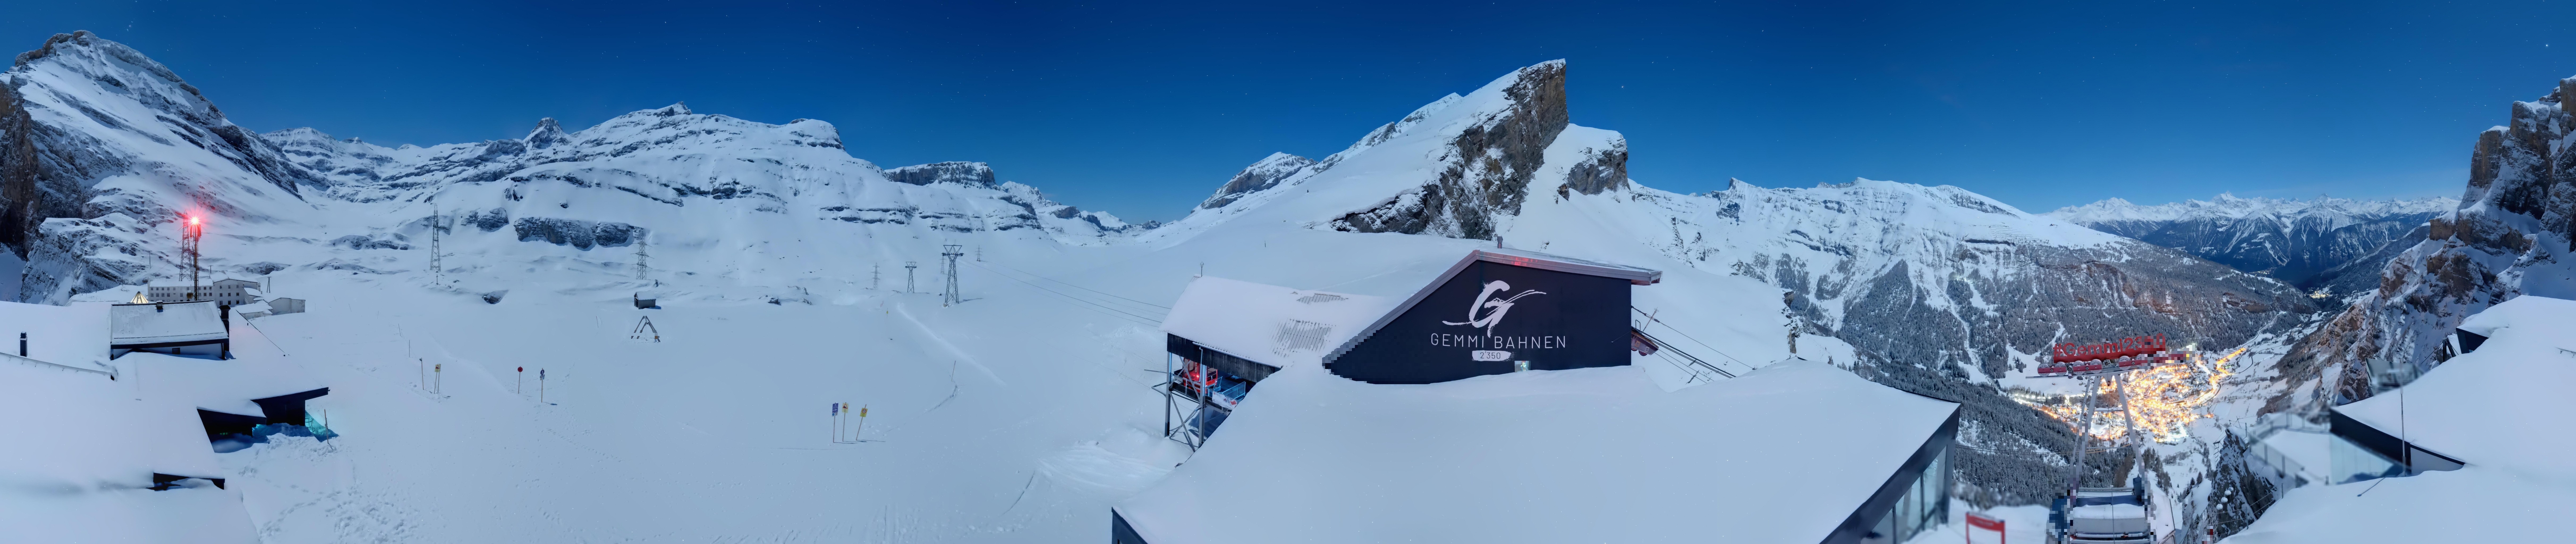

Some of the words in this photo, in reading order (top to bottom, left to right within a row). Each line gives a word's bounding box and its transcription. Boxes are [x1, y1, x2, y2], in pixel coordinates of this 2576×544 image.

[1431, 333, 1484, 348] GEMMI
[1494, 336, 1565, 348] BAHNEN
[2053, 333, 2165, 357] #Gemmi230
[1480, 351, 1501, 359] 2'350
